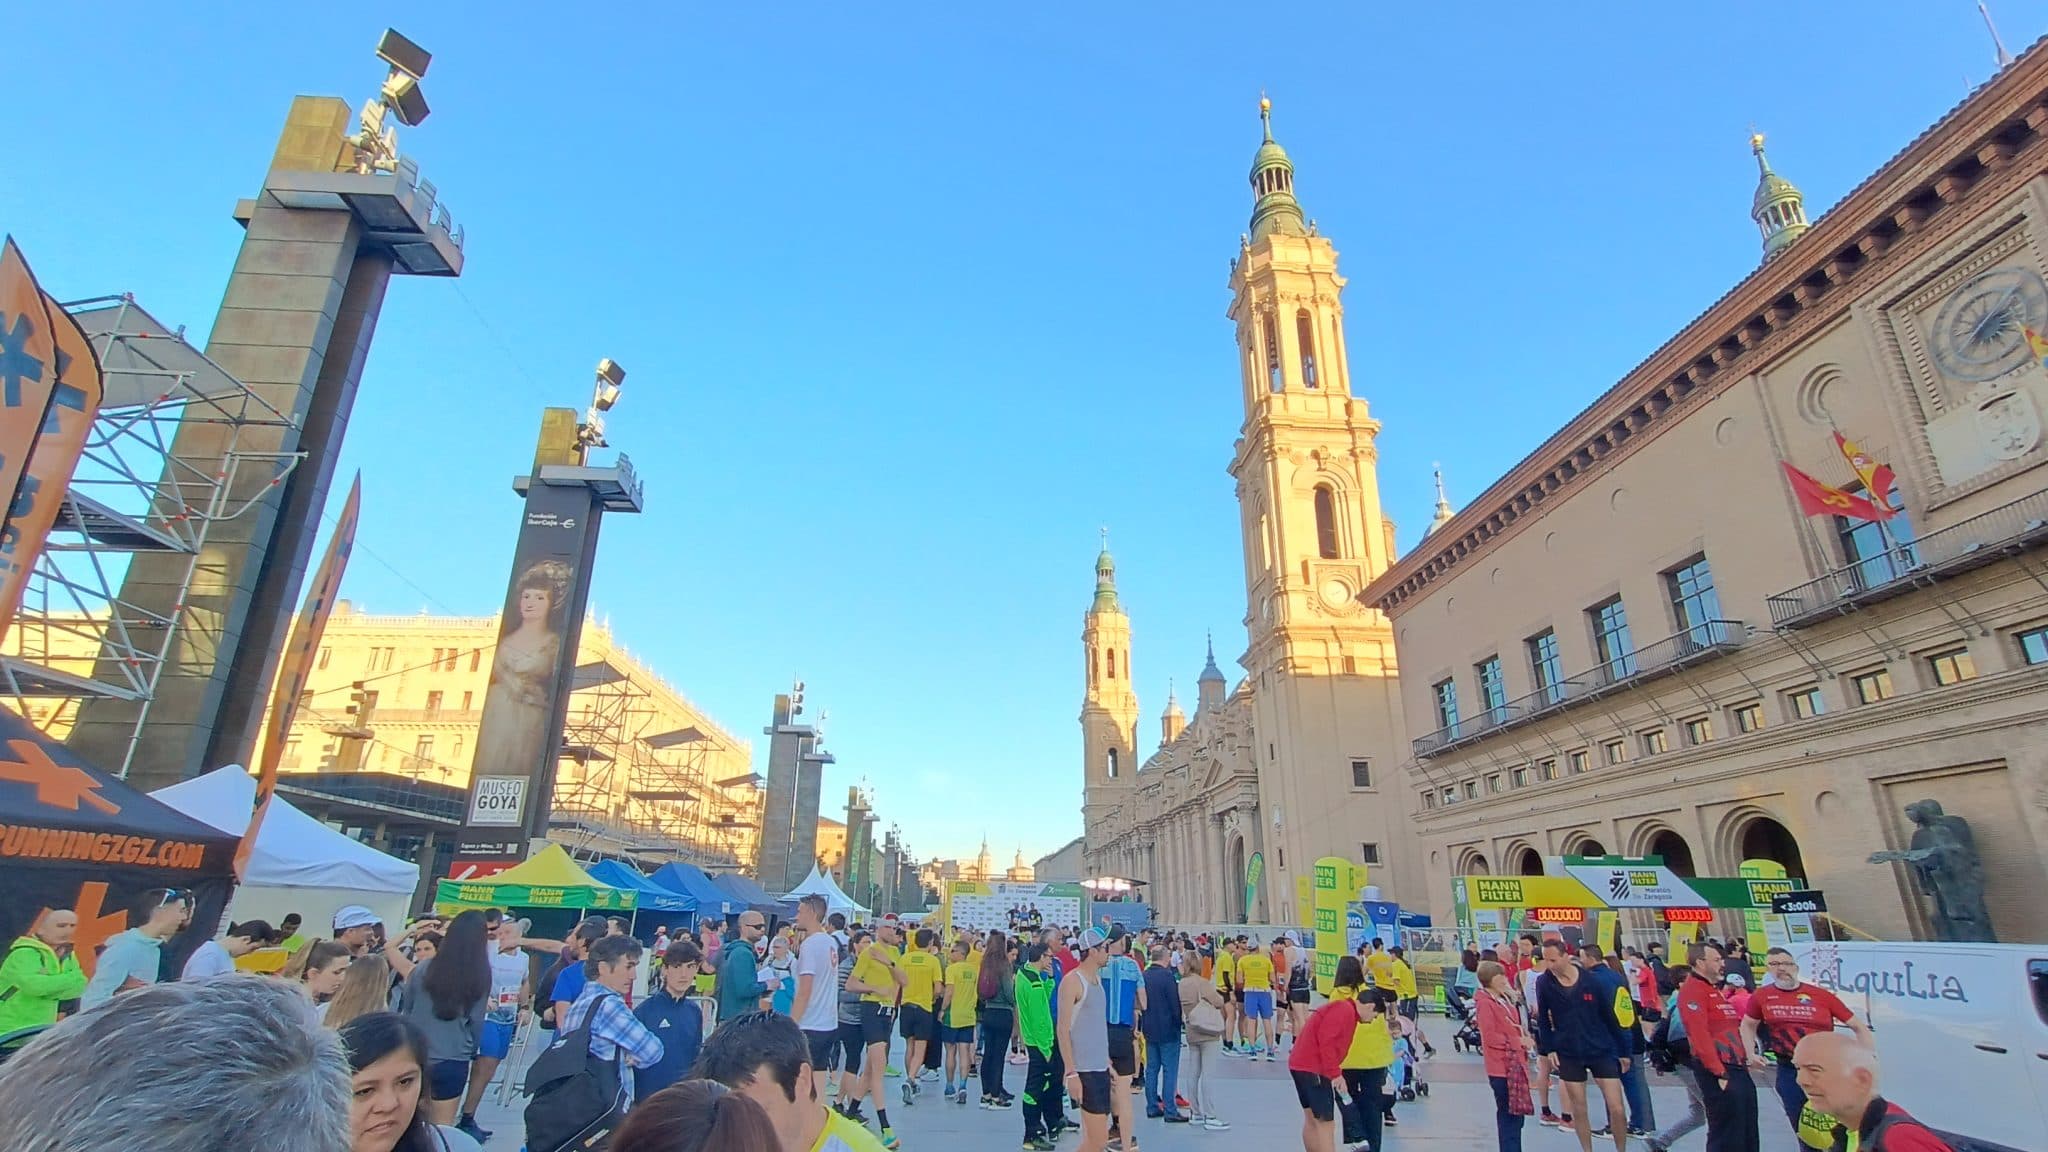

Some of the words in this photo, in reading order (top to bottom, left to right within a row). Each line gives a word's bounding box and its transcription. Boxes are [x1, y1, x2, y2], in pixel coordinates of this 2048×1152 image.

[480, 781, 521, 795] MUSEO
[478, 796, 517, 809] GOYA
[1480, 881, 1519, 890] MANN
[1631, 878, 1657, 886] FILTER
[460, 885, 495, 894] MANN
[530, 888, 564, 896] MANN
[1751, 883, 1790, 892] MANN
[458, 893, 493, 901] FILTER
[1481, 890, 1521, 900] FILTER
[528, 896, 562, 904] FILTER
